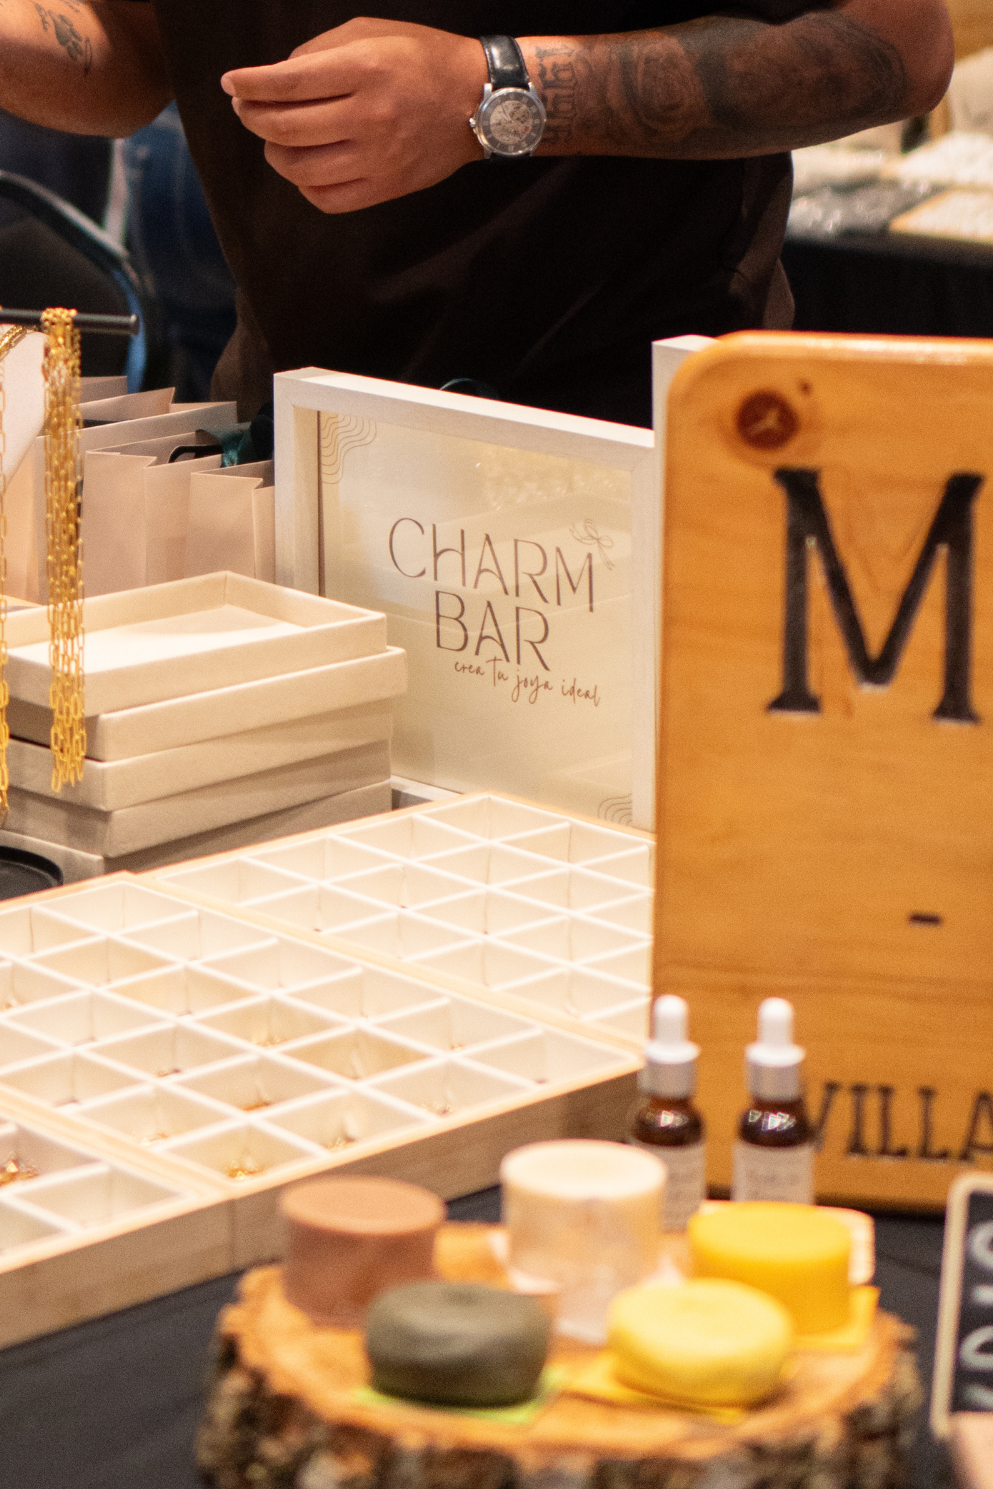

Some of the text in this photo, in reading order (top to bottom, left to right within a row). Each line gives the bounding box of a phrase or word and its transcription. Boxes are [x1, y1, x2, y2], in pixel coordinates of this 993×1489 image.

[388, 517, 594, 613] CHARM
[435, 590, 551, 672] BAR
[454, 661, 485, 676] crea
[511, 669, 554, 705] joya
[561, 677, 601, 707] ideal
